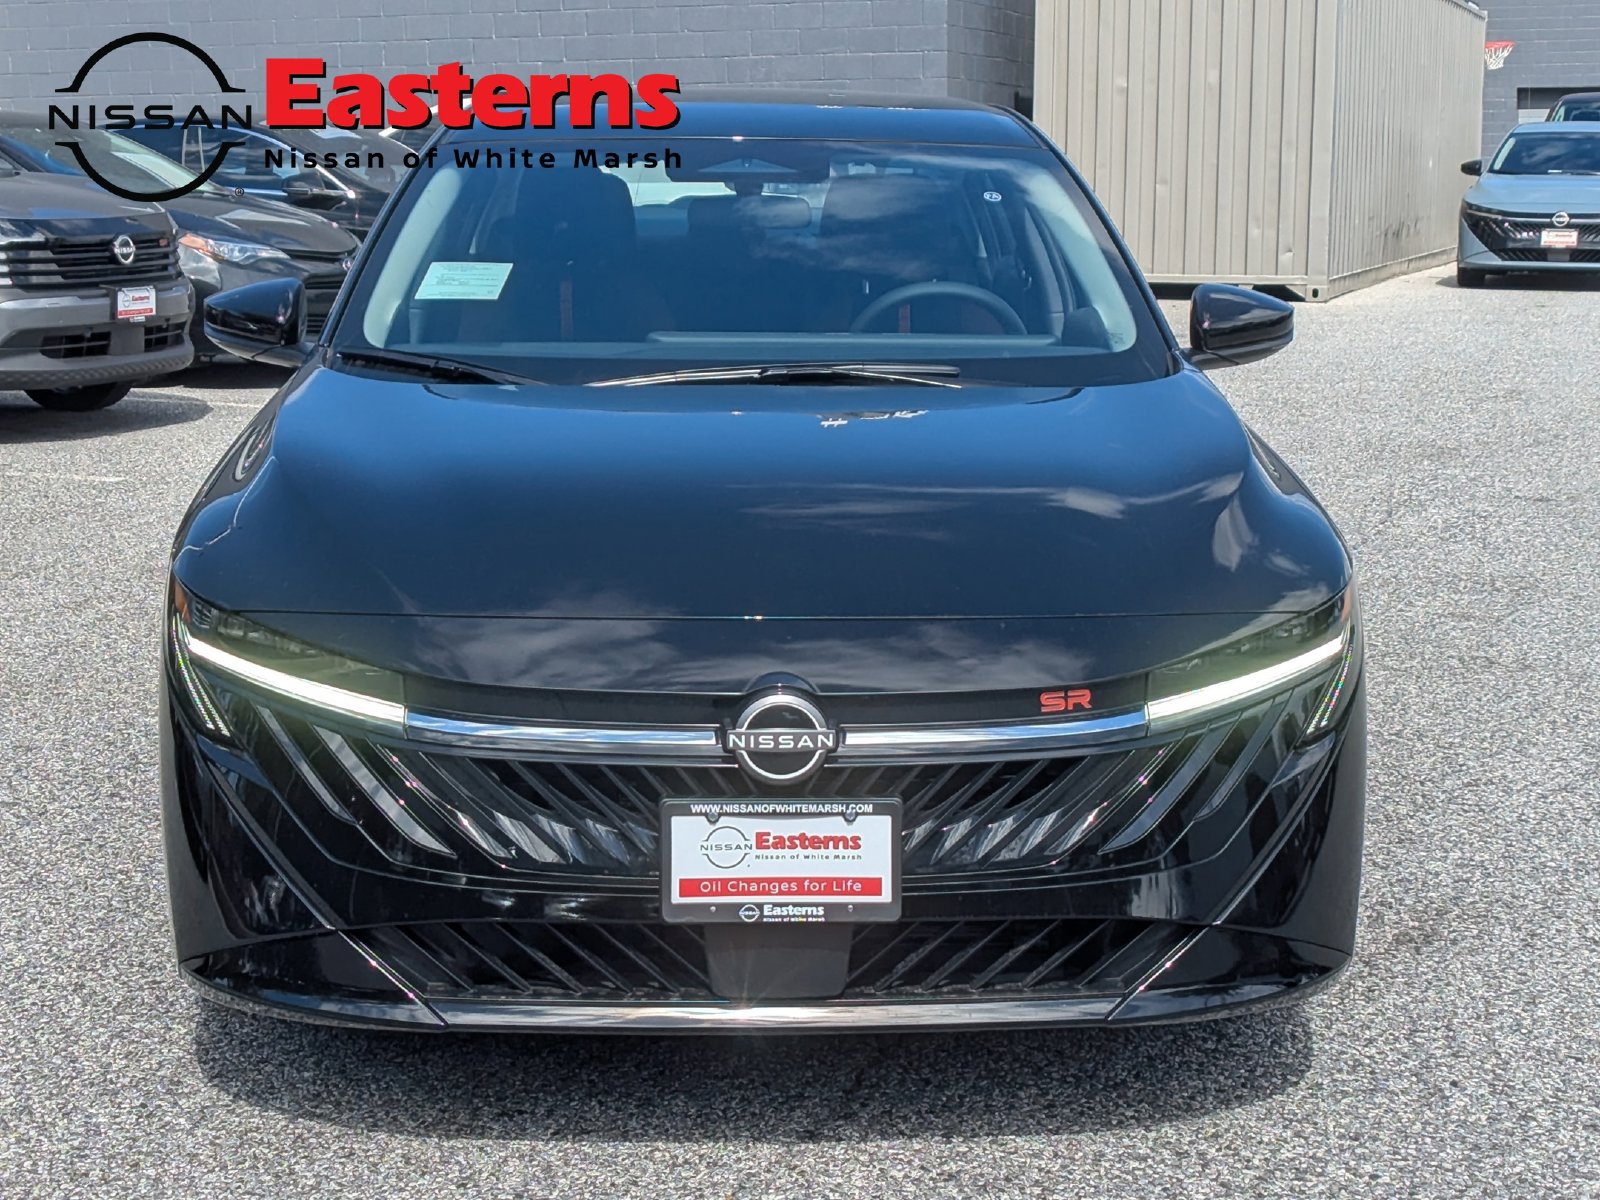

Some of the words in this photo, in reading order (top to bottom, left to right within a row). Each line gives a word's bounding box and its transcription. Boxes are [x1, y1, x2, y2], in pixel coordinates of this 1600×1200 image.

[1040, 689, 1092, 712] SR
[728, 733, 834, 749] NISSAN
[690, 803, 873, 814] WWW.NISSANOFWHITEMARSH.COM
[700, 843, 753, 851] NISSAN
[755, 832, 862, 850] Easterns
[803, 853, 830, 861] White
[833, 853, 862, 861] Marsh
[700, 881, 722, 893] Oil
[727, 879, 798, 895] Changes
[804, 880, 827, 892] for
[832, 879, 862, 892] Life
[763, 904, 825, 916] Easterns
